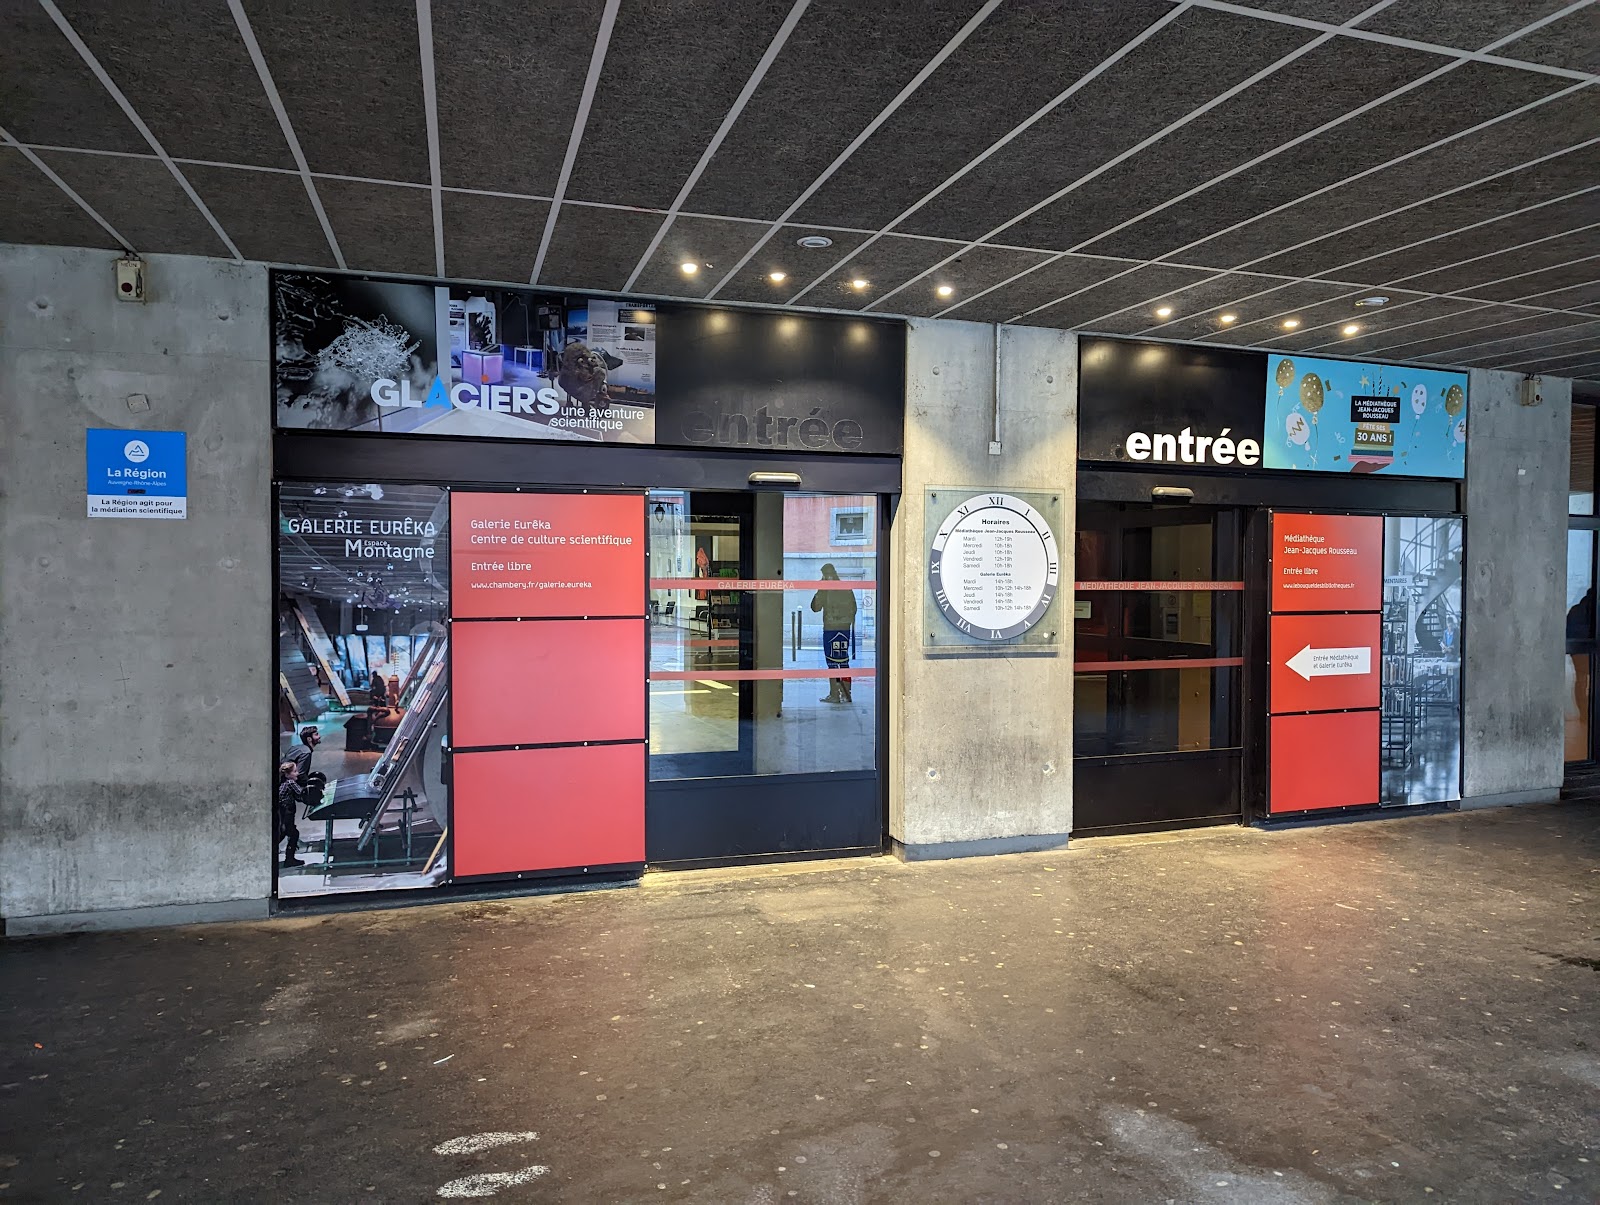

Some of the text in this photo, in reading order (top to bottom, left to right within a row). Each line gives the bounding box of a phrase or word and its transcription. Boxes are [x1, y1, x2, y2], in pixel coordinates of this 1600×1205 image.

[370, 375, 560, 416] GLACIERS
[1362, 400, 1397, 408] MÉDIATHÈQUE
[561, 407, 645, 420] une aventure
[550, 416, 624, 432] scientifique
[680, 405, 864, 450] entrée
[1363, 422, 1375, 430] FÊTE
[1357, 432, 1368, 441] 30
[1370, 432, 1388, 443] ANS
[1126, 427, 1260, 466] entrée
[107, 467, 167, 480] La Région
[112, 498, 138, 507] Région
[139, 499, 154, 507] agit
[988, 496, 1004, 506] XII
[139, 507, 183, 515] scientifique
[957, 505, 969, 517] XI
[288, 516, 436, 536] GALERIE EURÊKA
[470, 519, 552, 530] Galerie Eurêka
[981, 518, 1010, 526] Horaires
[939, 530, 949, 539] X
[1284, 533, 1325, 544] Médiathèque
[363, 539, 388, 547] Espace
[470, 534, 633, 547] Centre de culture scientifique
[345, 539, 435, 561] Montagne
[1283, 546, 1358, 555] Jean-Jacques Rousseau
[471, 561, 532, 571] Entrée libre
[1049, 561, 1057, 575] III
[1283, 567, 1319, 575] Entrée libre
[470, 581, 592, 590] www.chambery.fr/galerie.eureka
[718, 580, 795, 590] GALERIE EURÊKA
[1080, 581, 1234, 590] MEDIATHEQUE JEAN-JACQUES ROUSSEAU
[1329, 653, 1359, 661] Médiathèque
